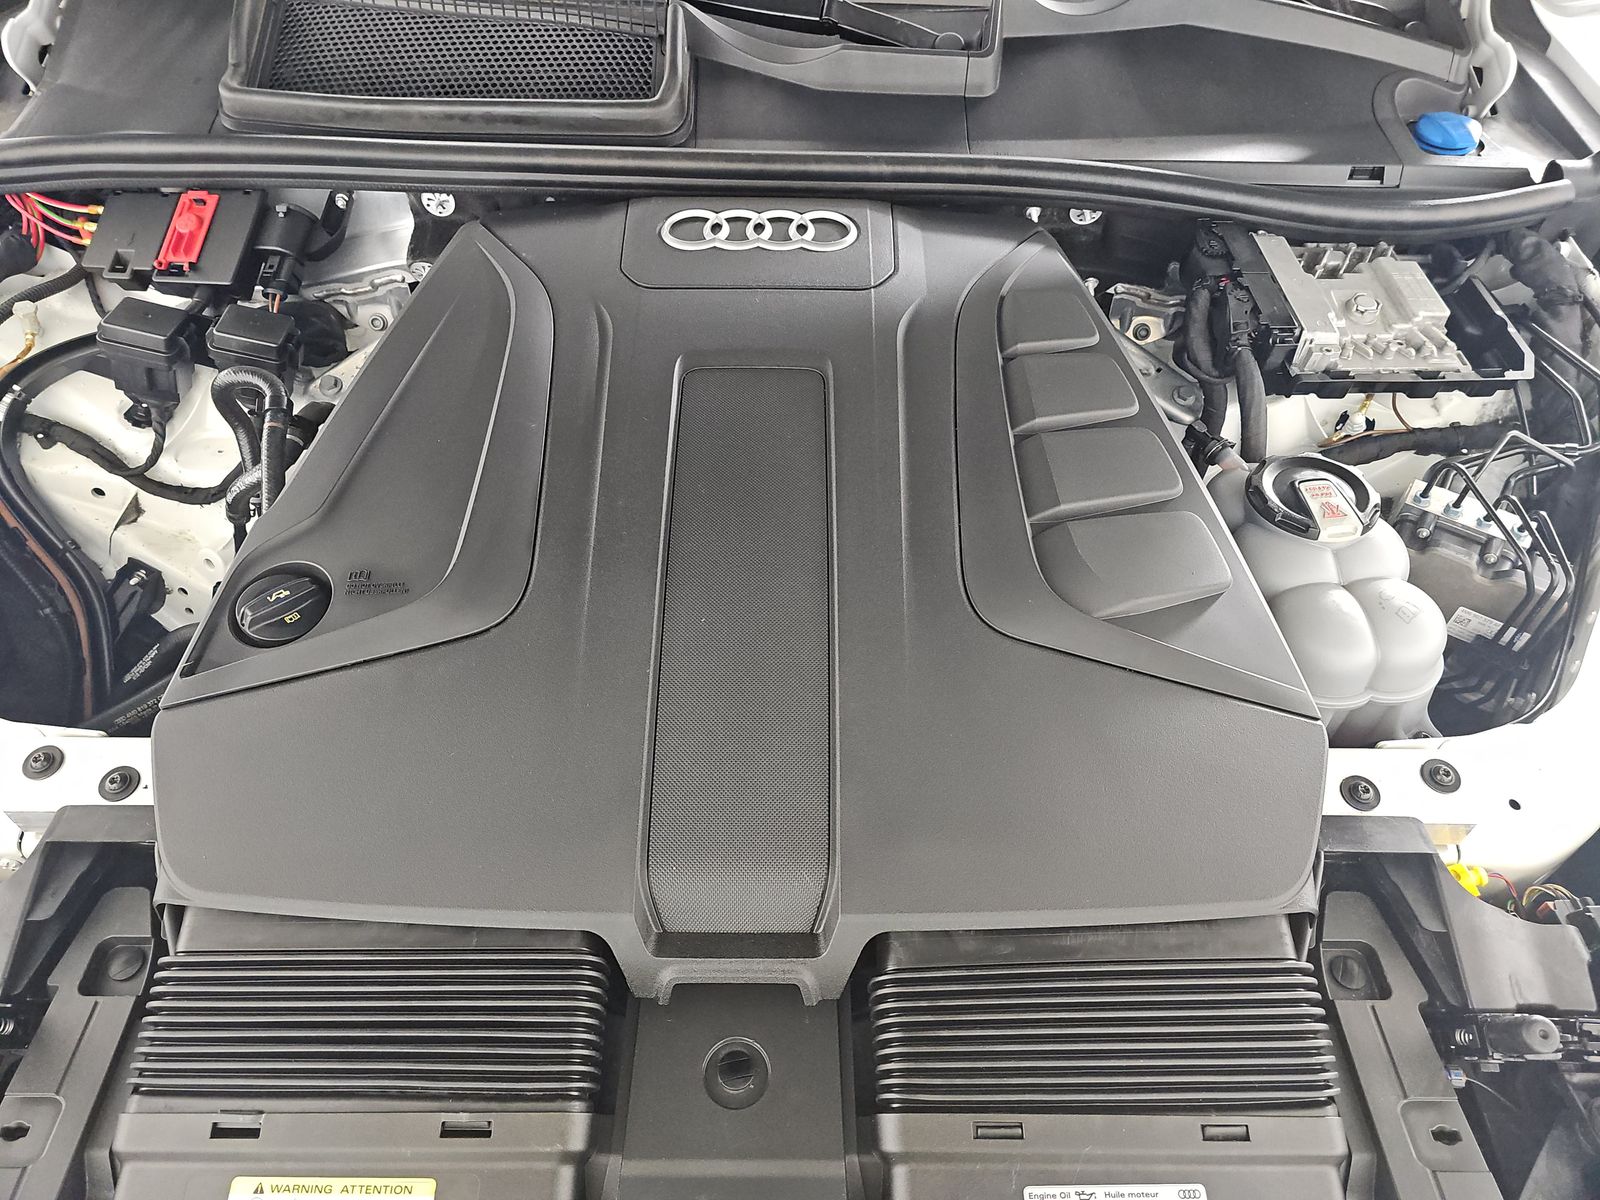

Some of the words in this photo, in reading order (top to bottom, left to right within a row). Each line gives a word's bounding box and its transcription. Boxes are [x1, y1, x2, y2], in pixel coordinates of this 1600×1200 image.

[270, 1184, 333, 1194] WARNING
[340, 1185, 413, 1195] ATTENTION
[1028, 1191, 1057, 1200] Engine
[1059, 1191, 1071, 1199] Oil
[1104, 1191, 1126, 1199] Huile
[1127, 1191, 1159, 1199] moteur
